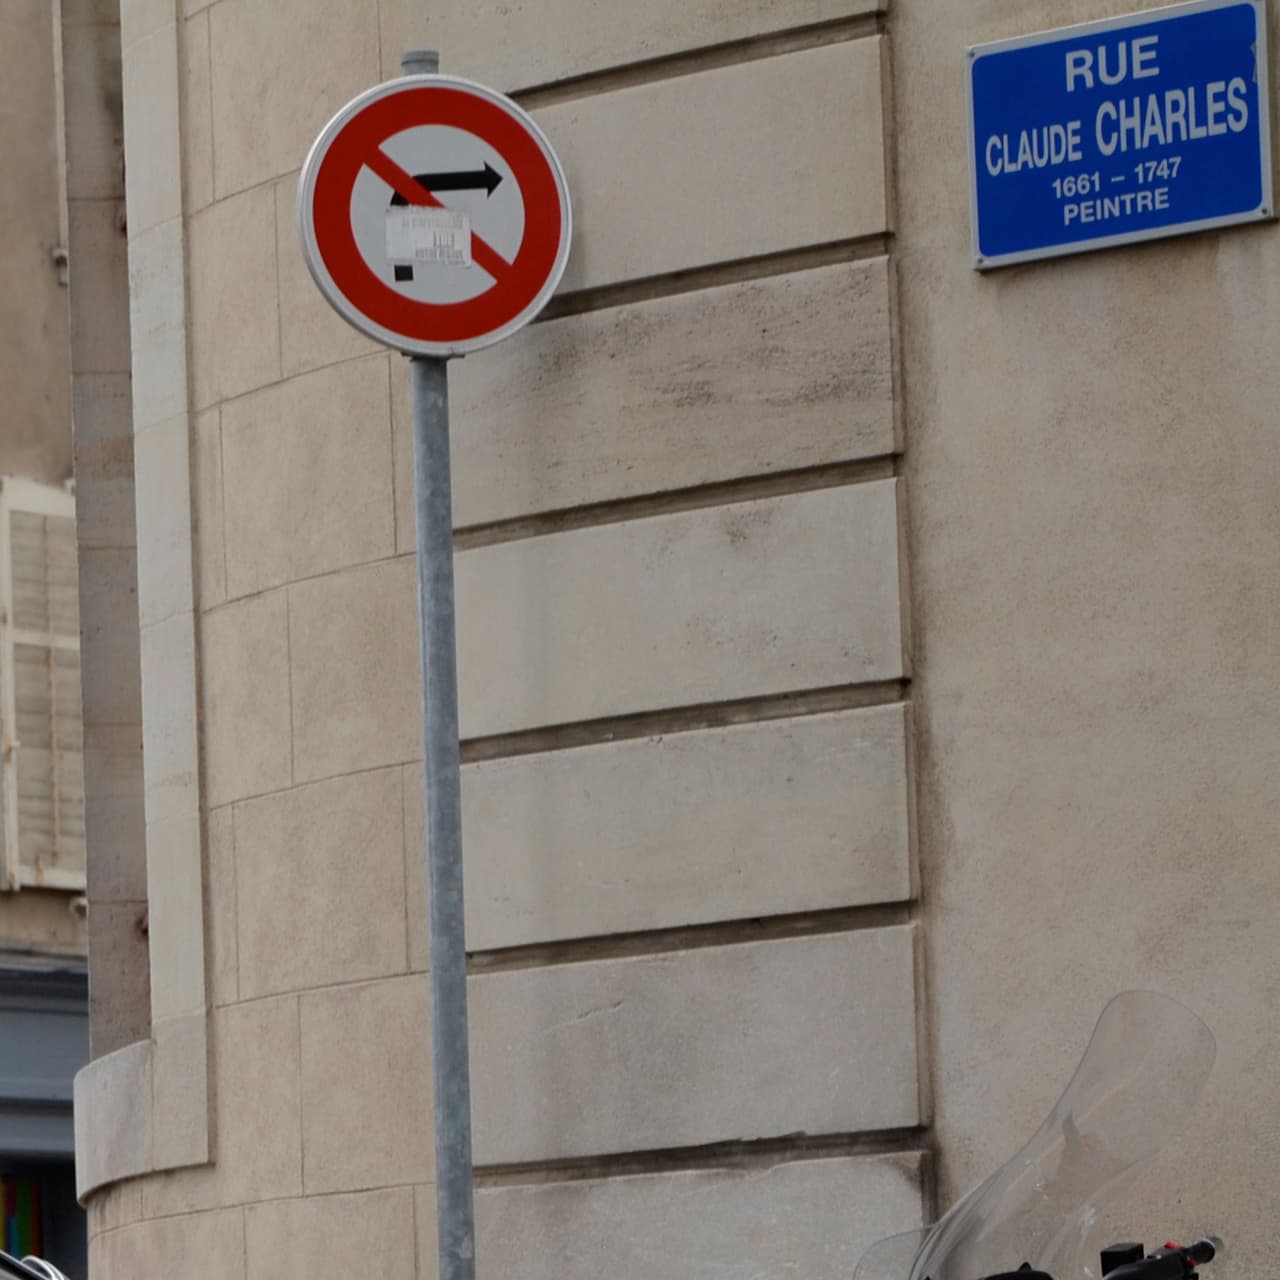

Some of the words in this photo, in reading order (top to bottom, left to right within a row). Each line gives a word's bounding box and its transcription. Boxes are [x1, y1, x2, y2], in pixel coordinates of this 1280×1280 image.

[1065, 35, 1160, 92] RUE
[985, 120, 1083, 176] CLAUDE
[1095, 76, 1249, 156] CHARLES
[1051, 171, 1101, 199] 1661
[1134, 156, 1182, 185] 1747
[1063, 187, 1170, 226] PEINTRE
